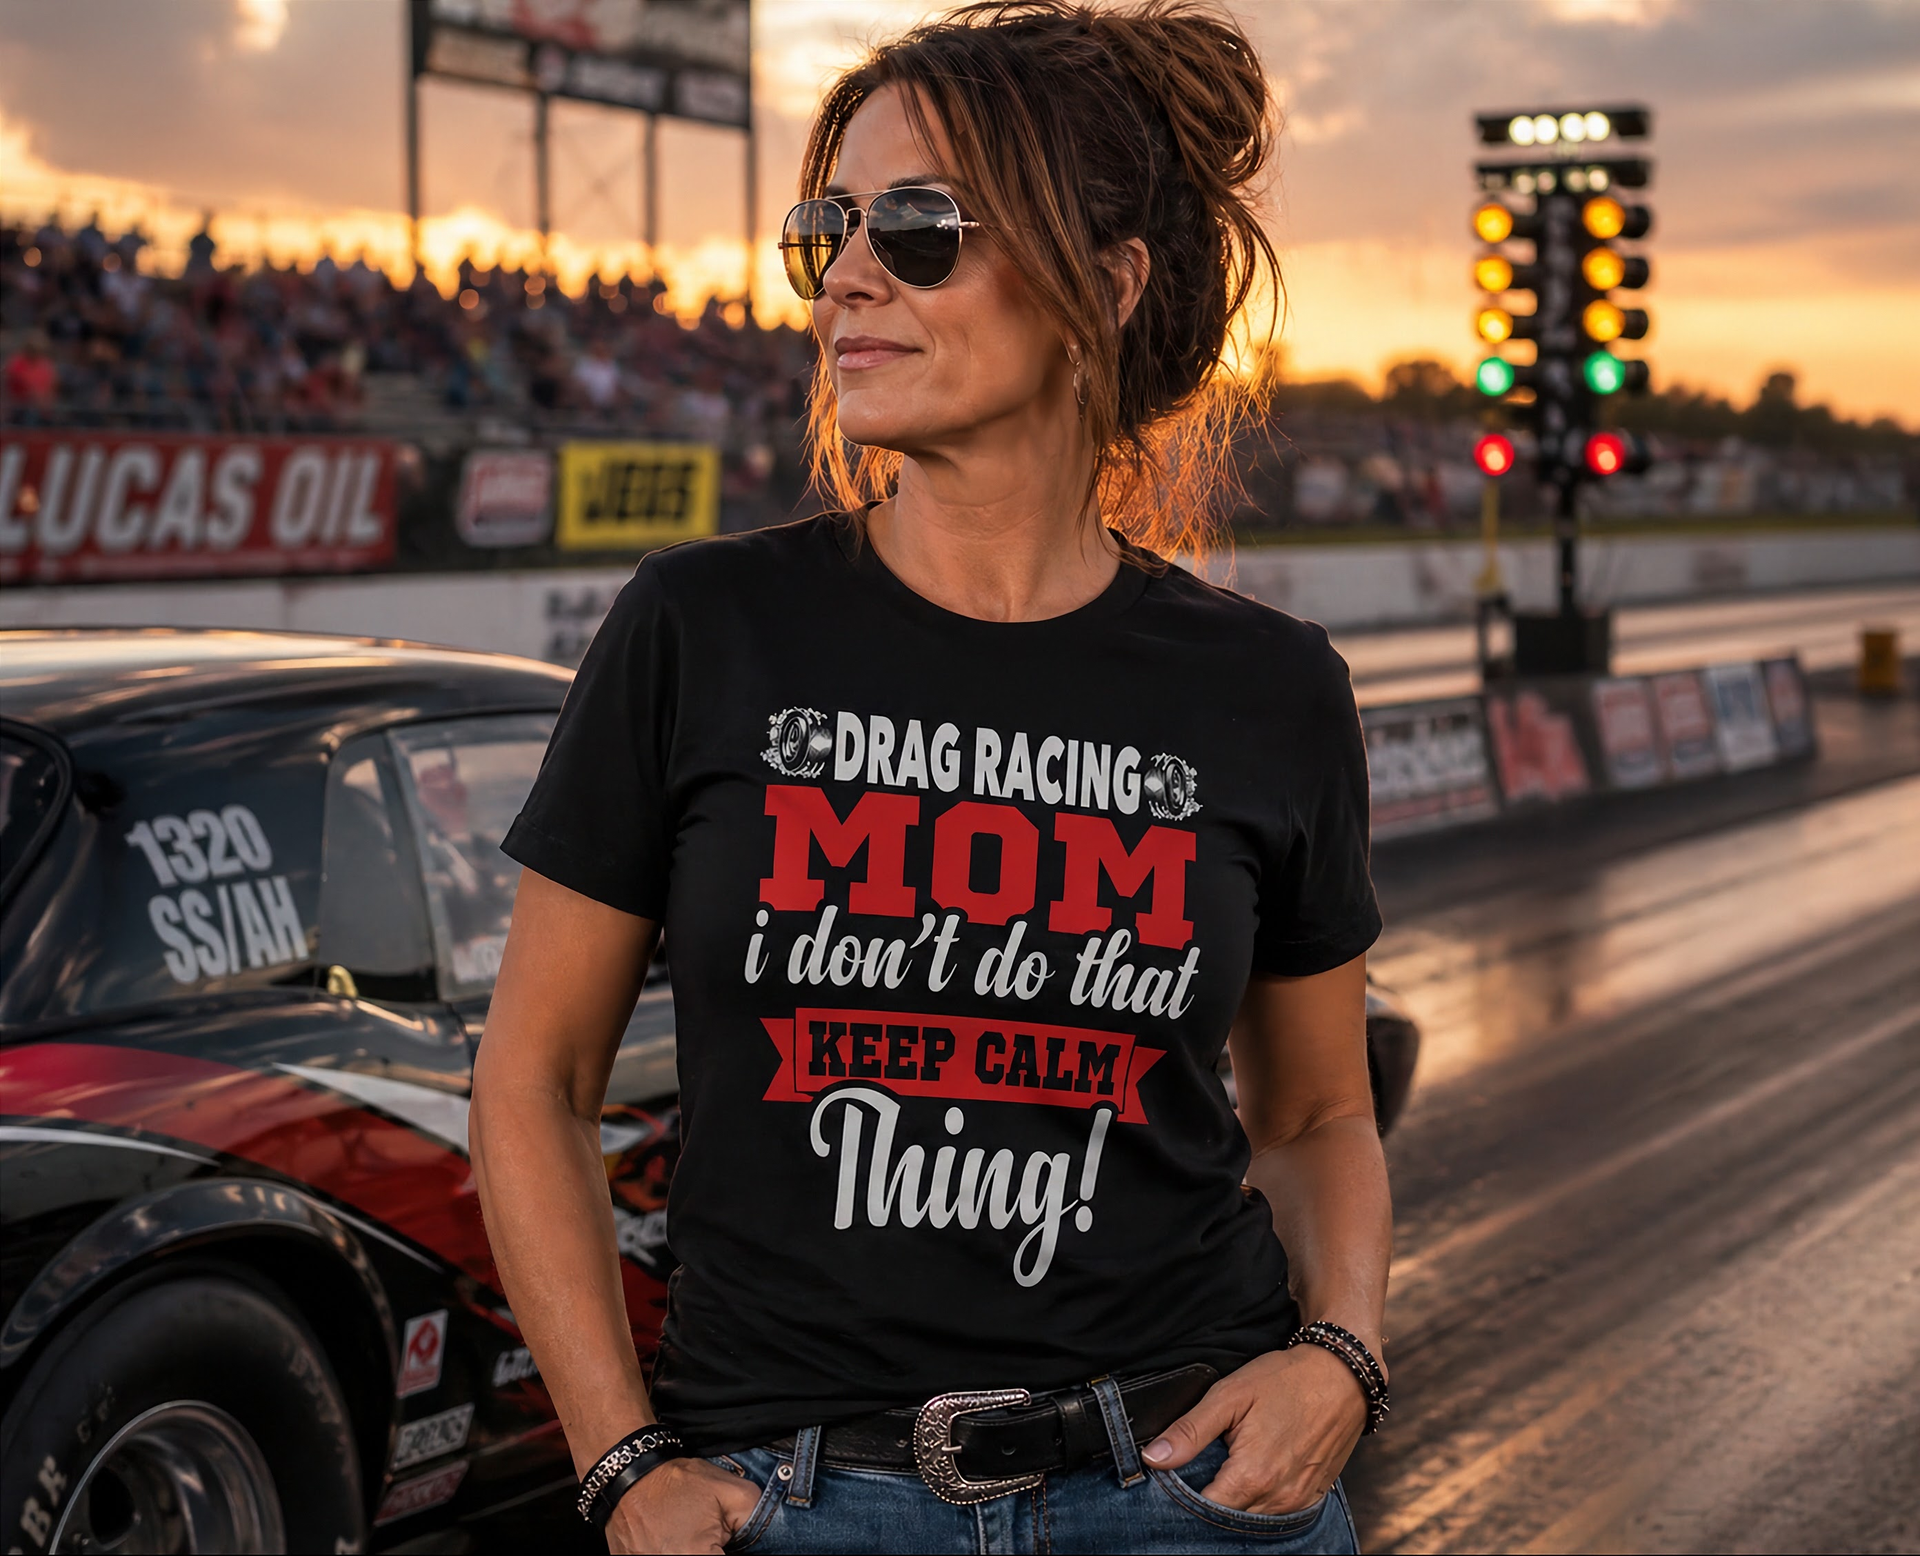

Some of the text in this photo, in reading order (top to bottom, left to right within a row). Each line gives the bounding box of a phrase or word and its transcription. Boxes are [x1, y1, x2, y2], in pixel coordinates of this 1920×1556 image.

[0, 441, 262, 556] LUCAS
[270, 444, 384, 548] OIL
[834, 711, 1141, 814] DRAG RACING
[124, 804, 273, 888] 1320
[759, 785, 1196, 950] MOM
[148, 875, 309, 984] SS/AH
[745, 905, 1200, 1019] i don't do that
[809, 1021, 1121, 1095] KEEP CALM
[810, 1088, 1112, 1287] Thing!
